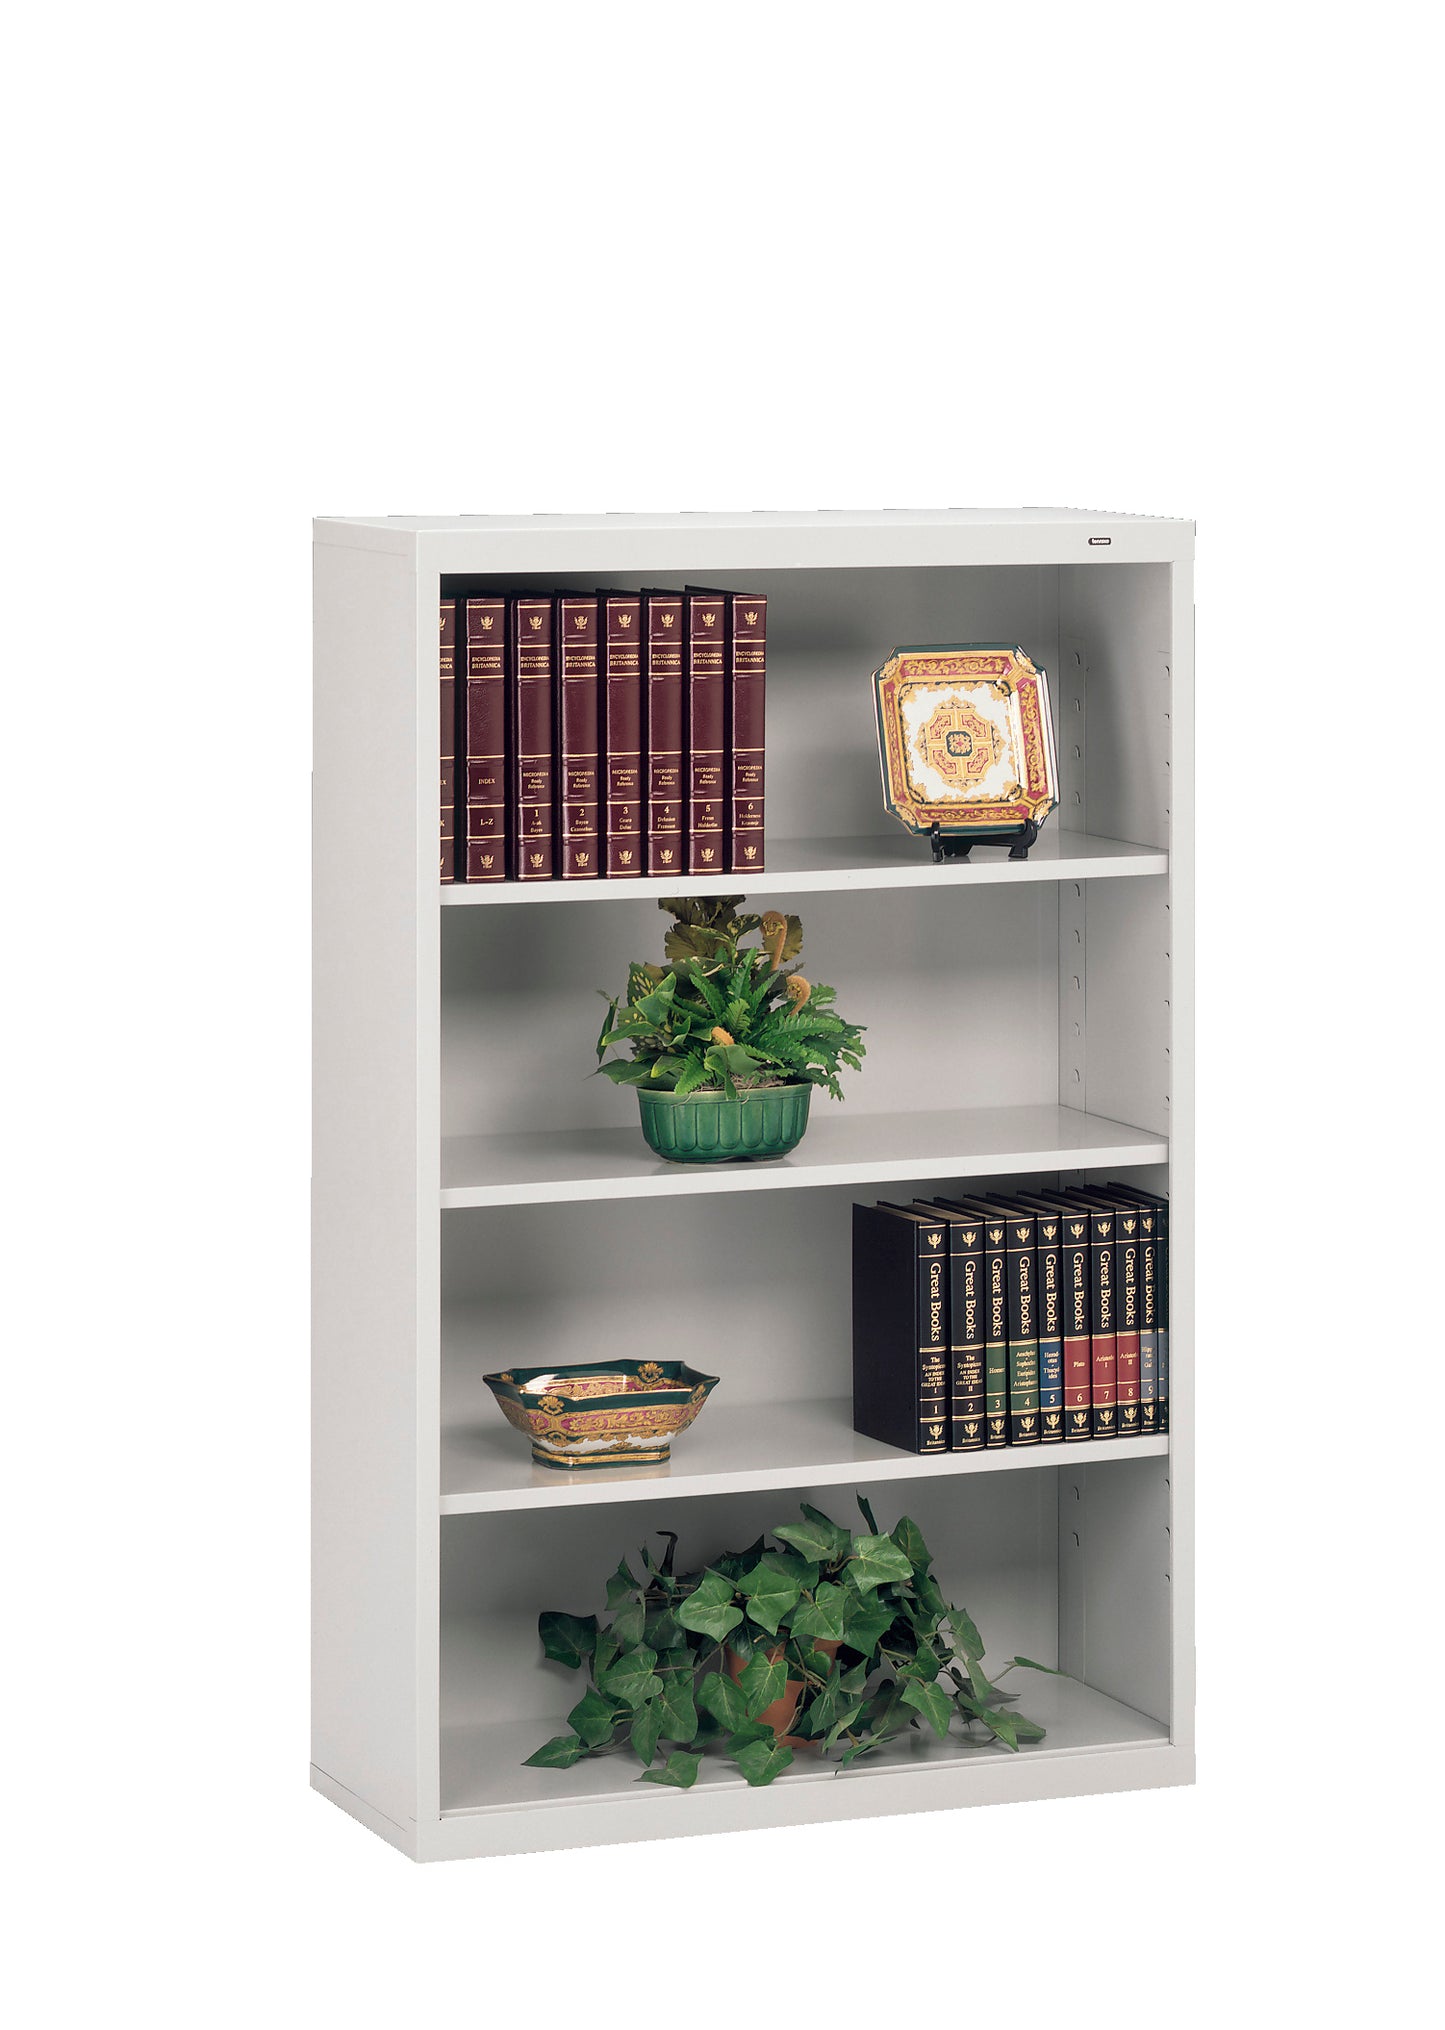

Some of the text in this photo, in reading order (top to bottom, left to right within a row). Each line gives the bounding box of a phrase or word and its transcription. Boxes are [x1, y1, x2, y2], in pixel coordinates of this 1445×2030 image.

[623, 806, 629, 814] 3
[664, 806, 670, 814] 4
[705, 804, 711, 813] 5
[747, 802, 754, 810] 6
[534, 809, 539, 817] 1
[579, 808, 585, 817] 2
[480, 818, 494, 826] L-Z
[1100, 1250, 1112, 1329] Great Books
[1125, 1248, 1137, 1326] Great Books
[1144, 1246, 1155, 1325] Great Books
[1020, 1256, 1032, 1335] Great Books
[1045, 1253, 1058, 1332] Great Books
[1073, 1252, 1085, 1331] Great Books
[930, 1262, 942, 1342] Great Books
[965, 1260, 977, 1340] Great Books
[992, 1258, 1004, 1337] Great Books
[1128, 1387, 1134, 1396] 8
[1148, 1385, 1153, 1395] 9
[1049, 1394, 1055, 1403] 5
[1077, 1393, 1083, 1402] 6
[1104, 1391, 1110, 1399] 7
[995, 1399, 1001, 1408] 3
[1024, 1397, 1030, 1406] 4
[934, 1405, 938, 1414] 1
[967, 1403, 974, 1412] 2
